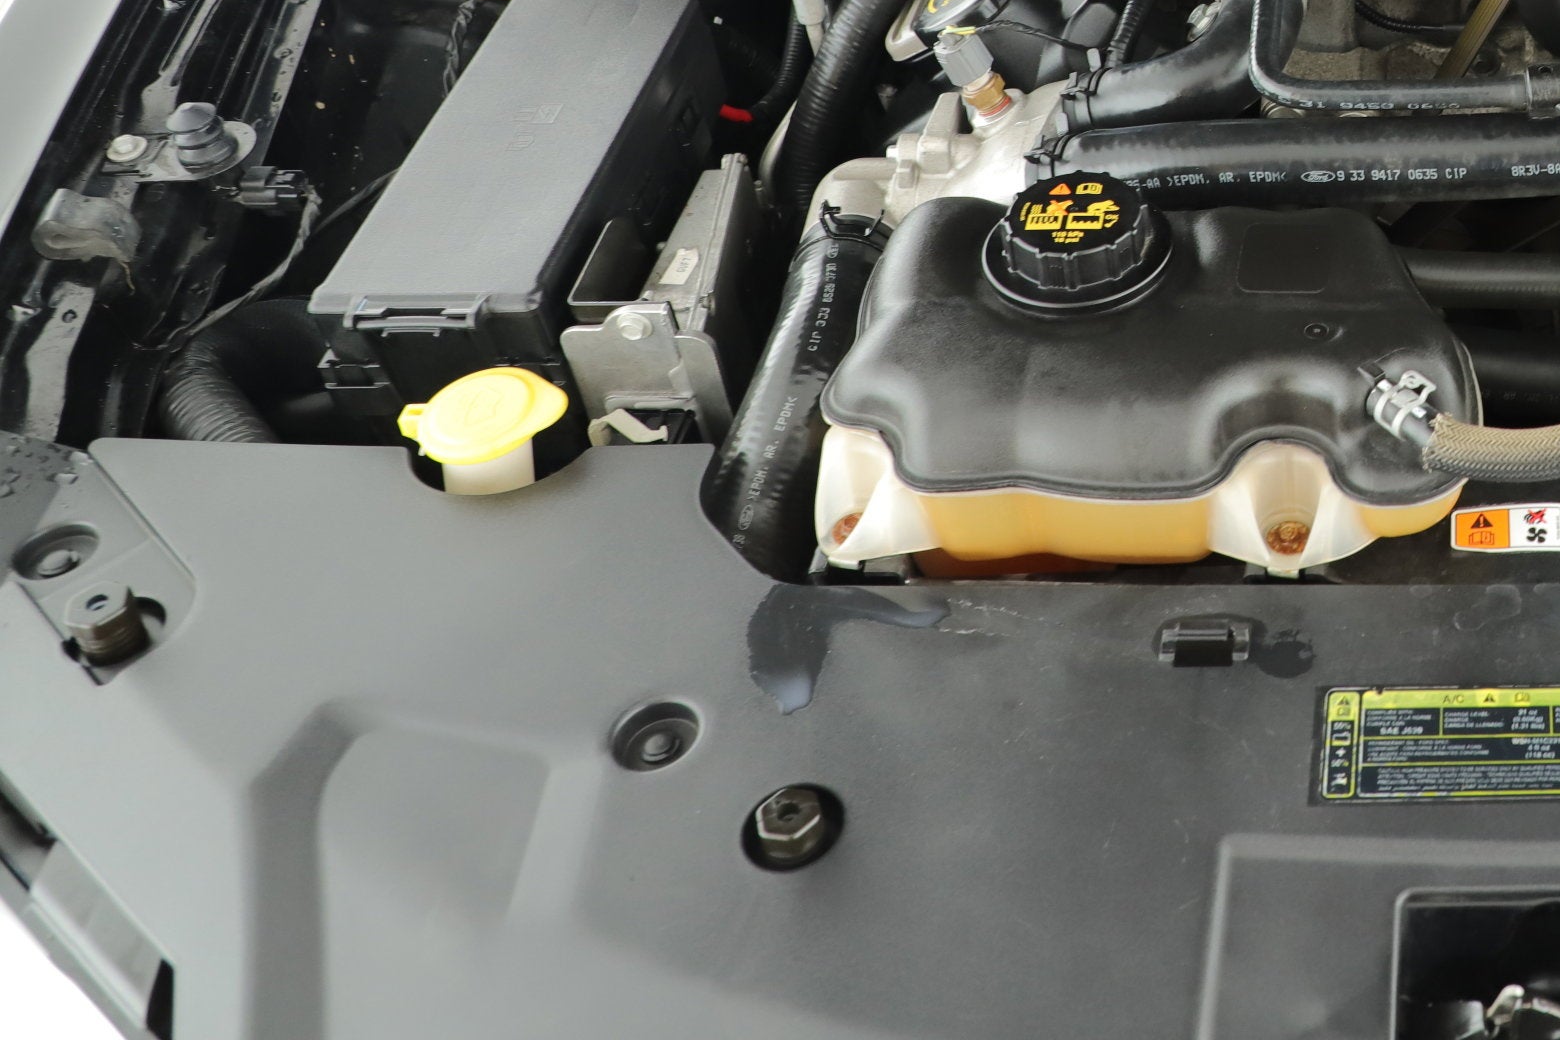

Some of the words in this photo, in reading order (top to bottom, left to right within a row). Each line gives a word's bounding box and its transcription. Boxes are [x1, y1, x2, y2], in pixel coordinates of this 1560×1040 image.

[1304, 171, 1334, 182] Ford
[1350, 170, 1365, 181] 33
[1371, 169, 1401, 181] 9417
[1407, 168, 1438, 180] 0635
[1445, 167, 1467, 179] CIP
[1443, 695, 1464, 704] A/C
